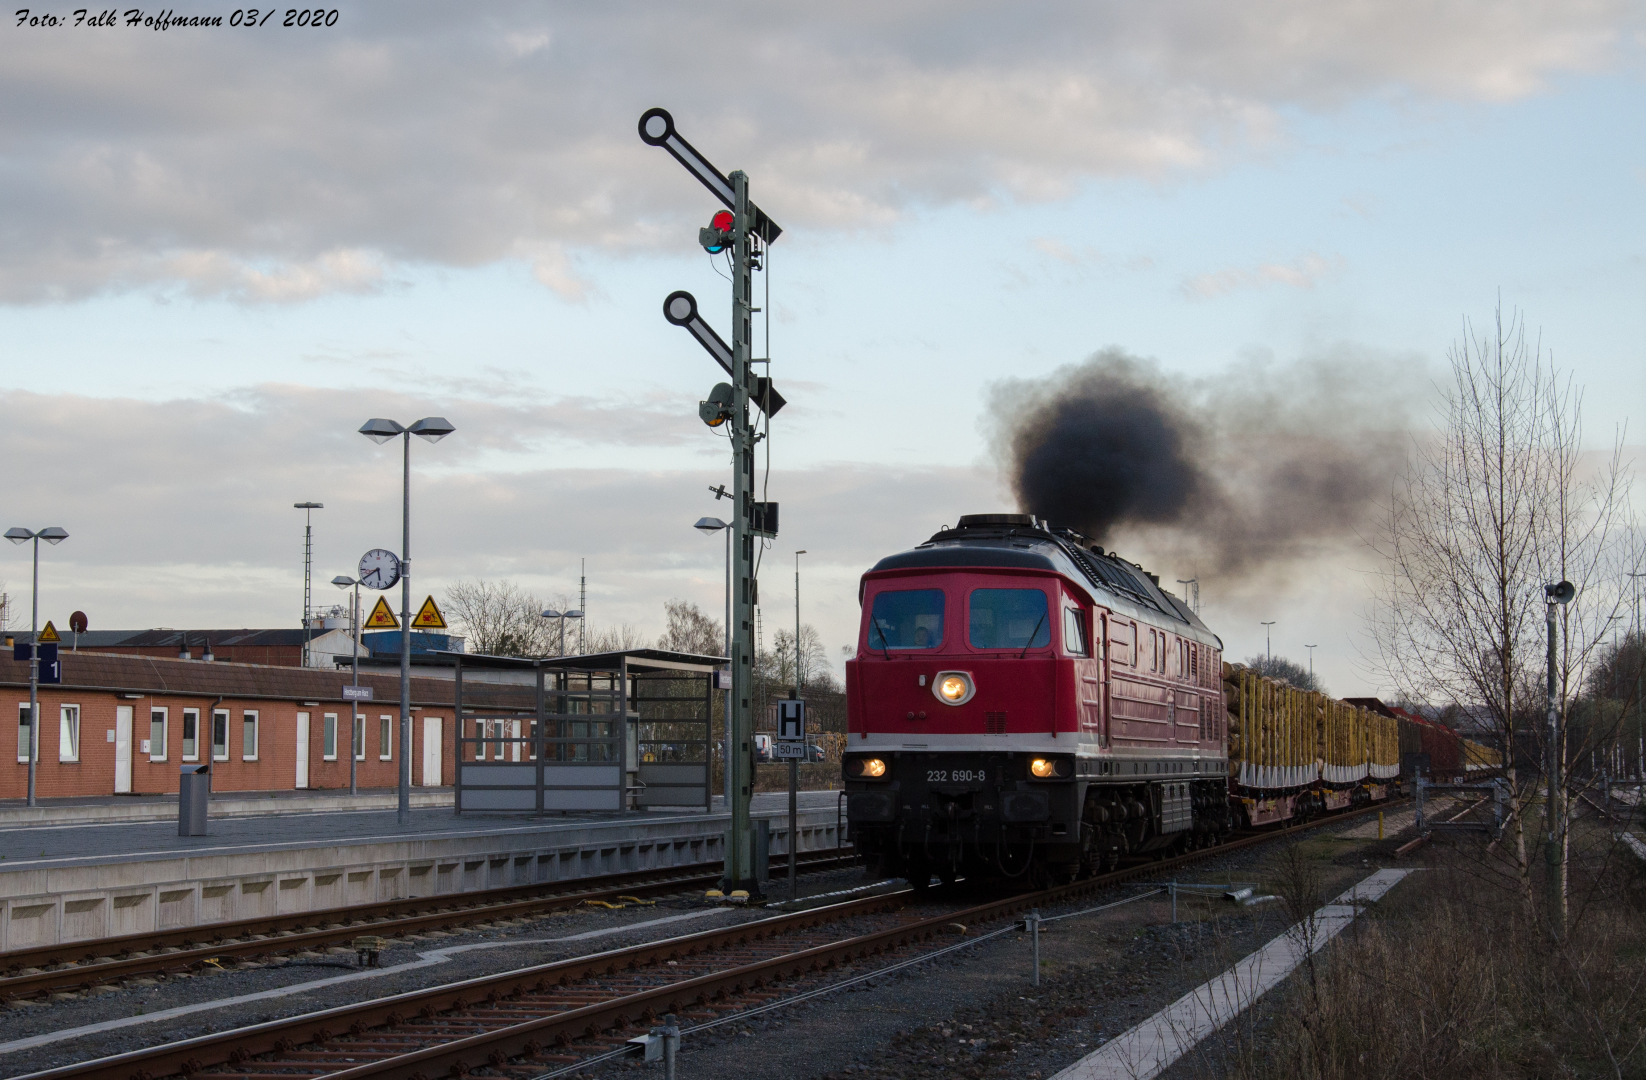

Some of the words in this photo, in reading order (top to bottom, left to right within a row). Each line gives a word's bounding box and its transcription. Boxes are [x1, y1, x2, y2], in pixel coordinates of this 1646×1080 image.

[50, 661, 58, 679] 1
[780, 703, 802, 737] H
[780, 744, 791, 755] 50
[792, 747, 802, 755] m
[926, 770, 947, 782] 232
[952, 770, 986, 782] 690-8
